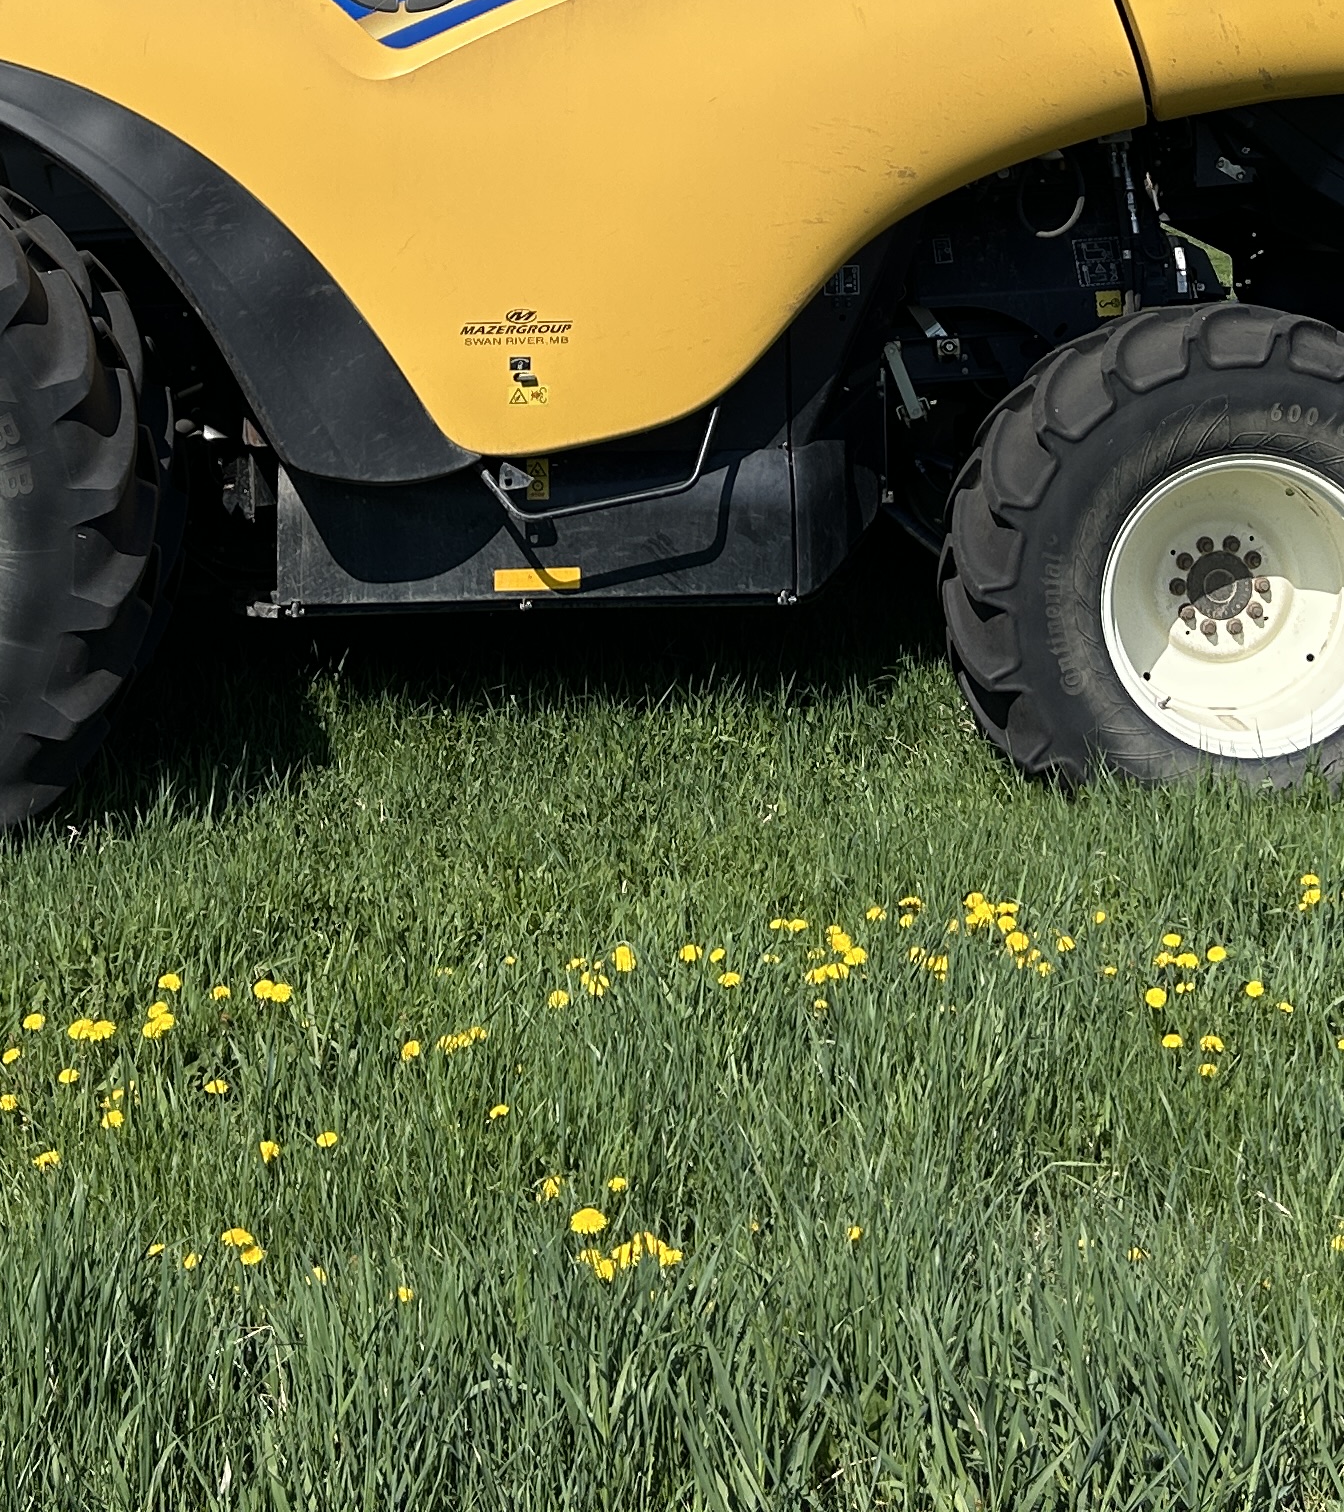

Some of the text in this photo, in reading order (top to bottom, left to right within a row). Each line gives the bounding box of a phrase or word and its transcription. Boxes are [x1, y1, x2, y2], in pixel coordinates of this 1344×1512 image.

[460, 324, 572, 335] MAZERGROUP
[464, 337, 501, 346] SWAN
[1039, 551, 1084, 696] Continental
